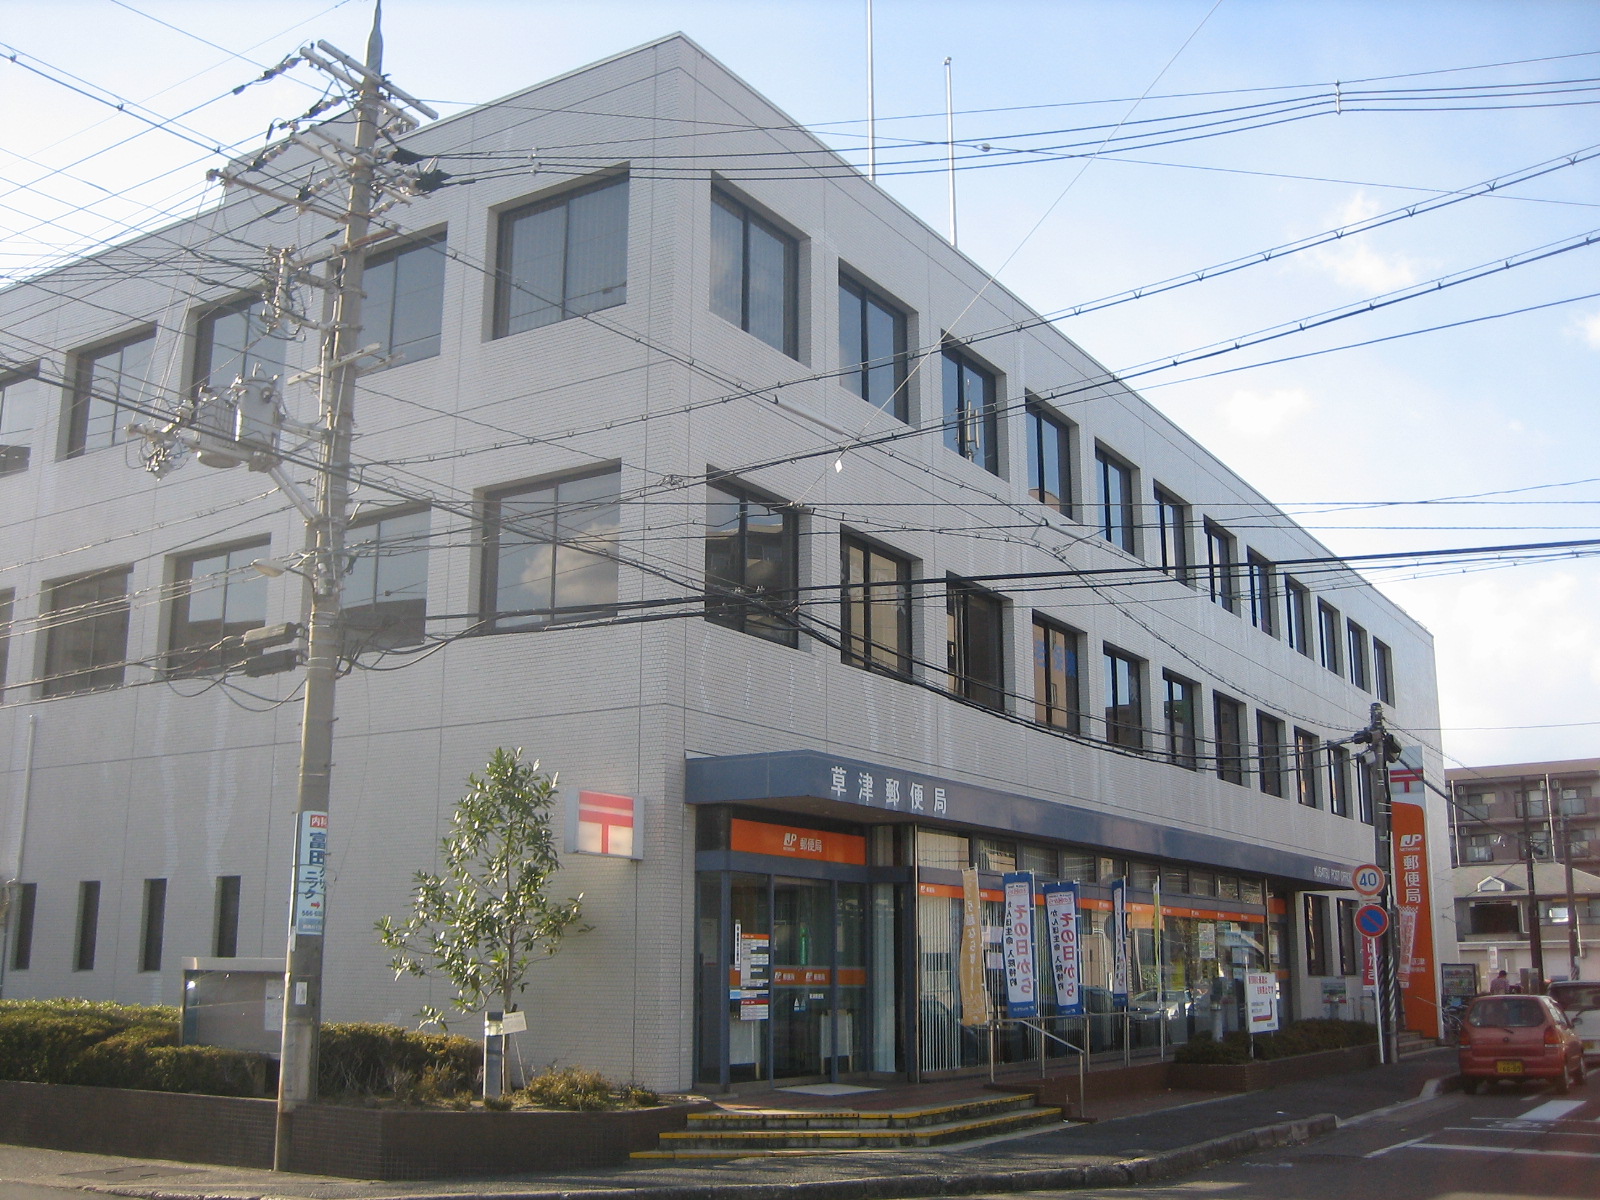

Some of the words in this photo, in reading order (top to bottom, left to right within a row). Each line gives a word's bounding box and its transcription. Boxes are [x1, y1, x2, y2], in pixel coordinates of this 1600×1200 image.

[830, 766, 948, 815] 草津郵便局
[800, 837, 823, 853] 郵便局
[1359, 872, 1377, 887] 40
[1403, 854, 1421, 903] 郵便局
